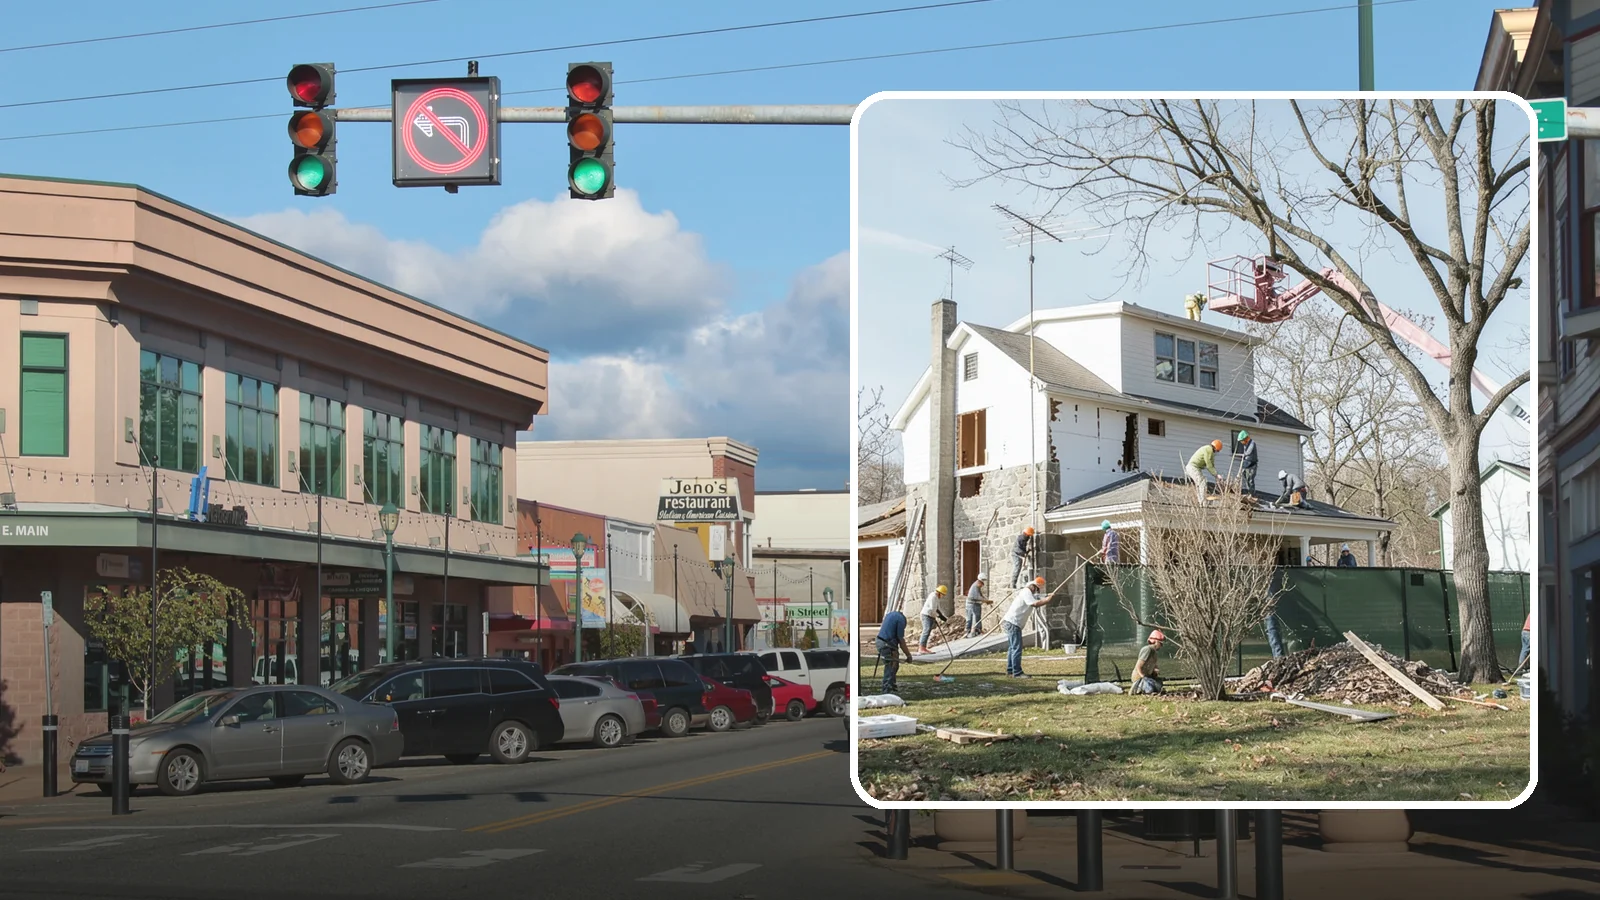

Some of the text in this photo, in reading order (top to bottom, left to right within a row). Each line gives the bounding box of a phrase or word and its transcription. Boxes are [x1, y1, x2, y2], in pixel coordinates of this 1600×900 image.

[669, 480, 727, 494] Jeno's
[665, 496, 731, 509] restaurant
[658, 509, 681, 519] Italian
[686, 509, 714, 519] American
[714, 509, 738, 519] Cuisine
[2, 525, 49, 537] E. MAIN
[797, 607, 829, 617] Street
